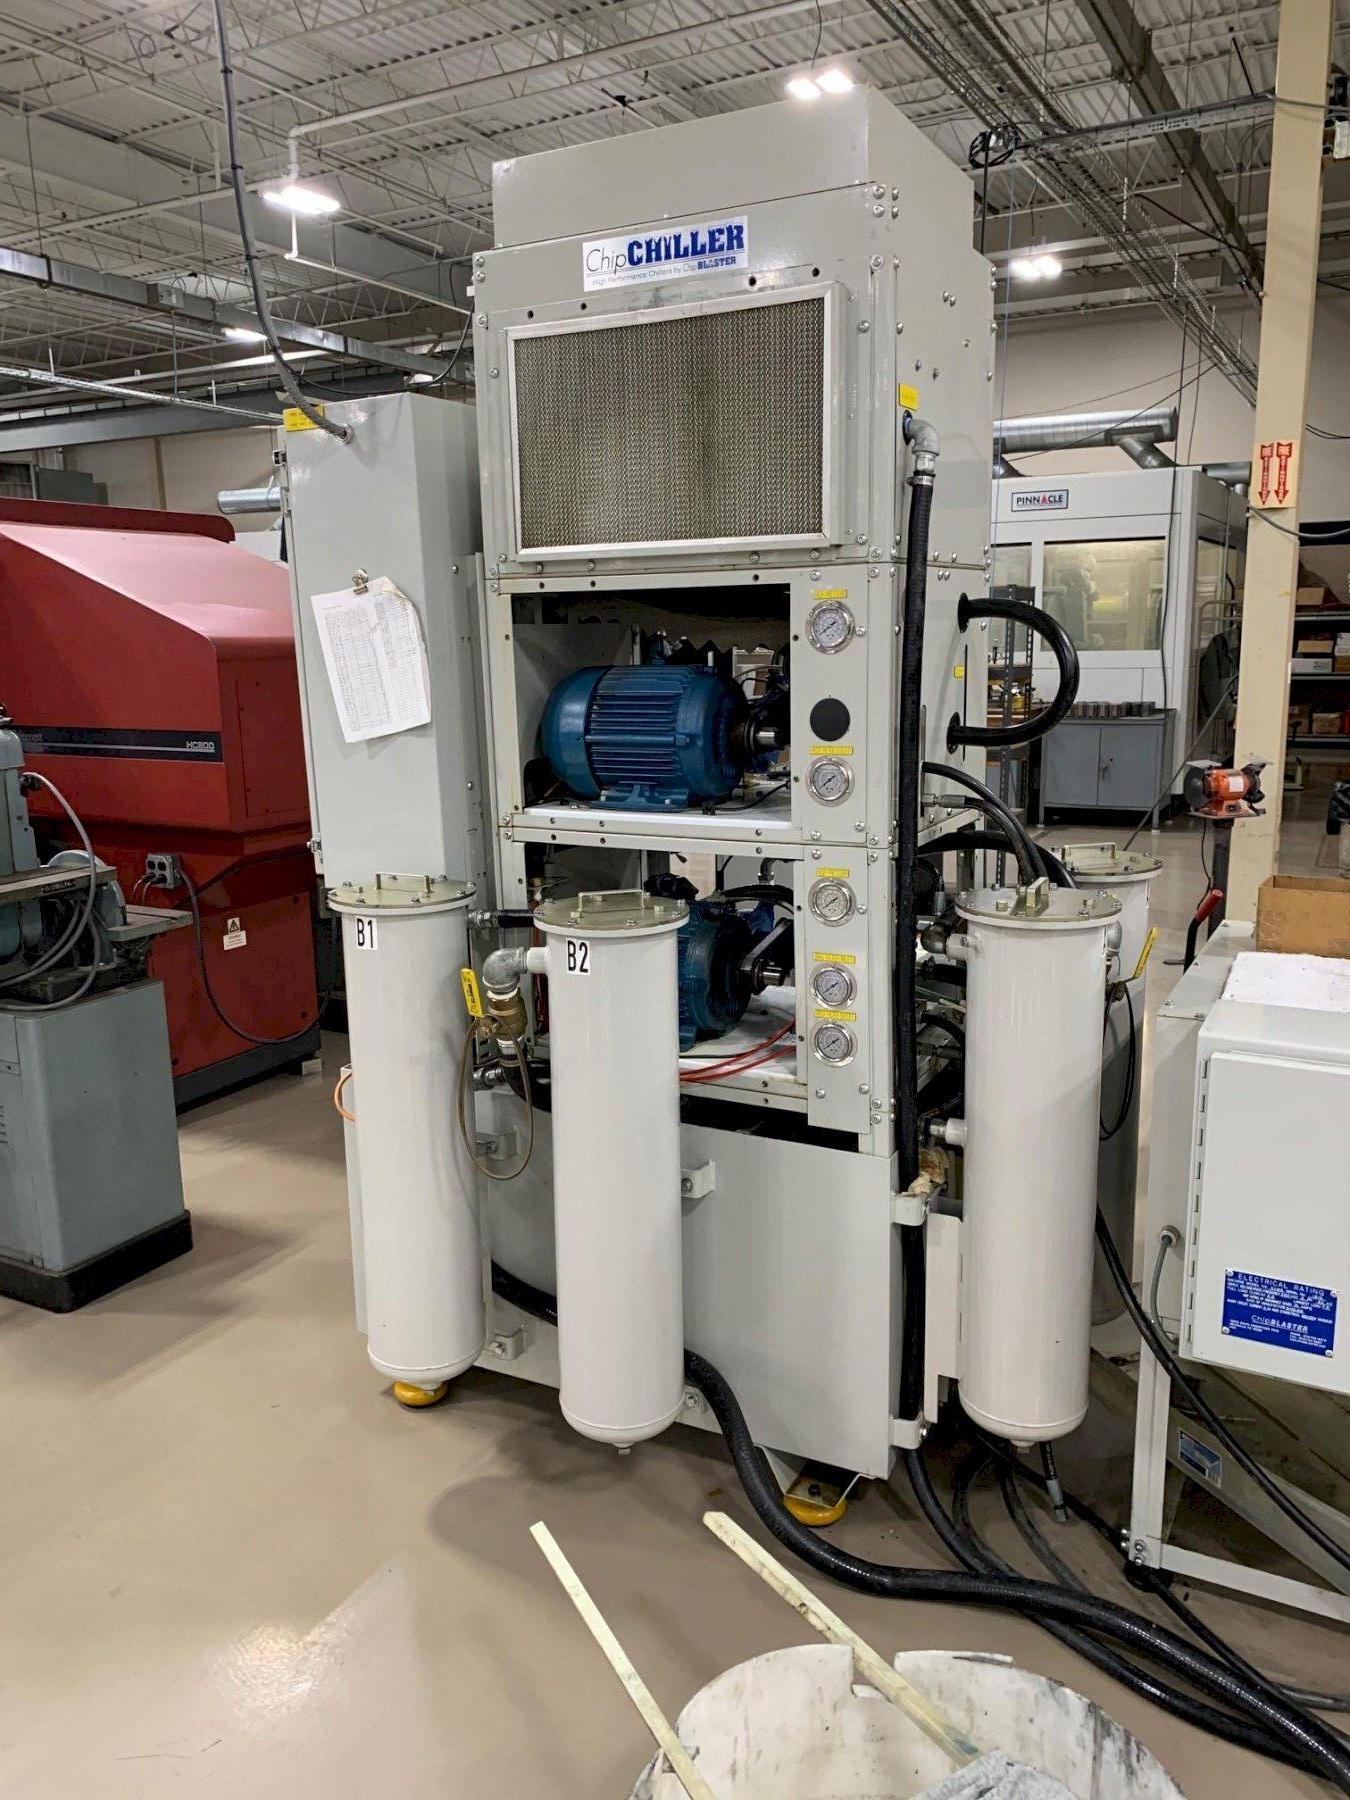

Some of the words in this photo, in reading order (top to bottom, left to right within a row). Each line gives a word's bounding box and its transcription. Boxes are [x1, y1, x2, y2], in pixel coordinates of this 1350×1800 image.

[1016, 495, 1064, 505] PINNACLE
[357, 918, 373, 948] B1
[568, 940, 588, 972] B2
[1238, 1273, 1288, 1289] ELECTRICAL
[1293, 1284, 1325, 1297] RATING
